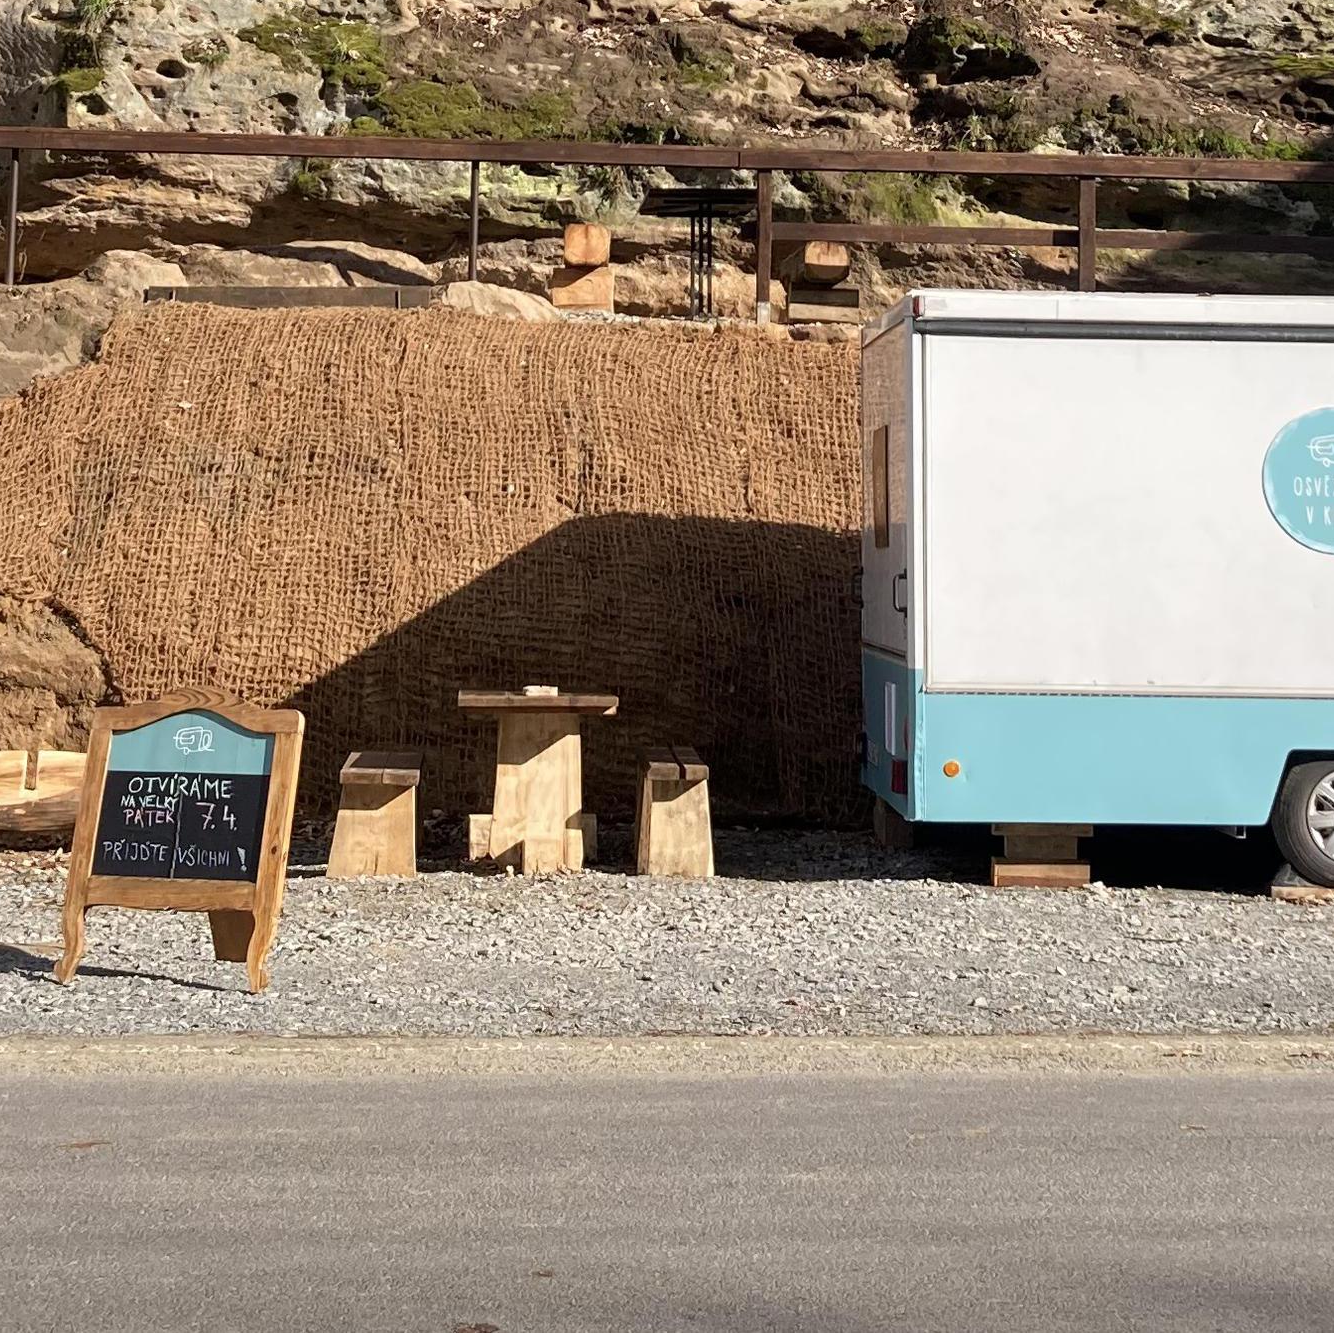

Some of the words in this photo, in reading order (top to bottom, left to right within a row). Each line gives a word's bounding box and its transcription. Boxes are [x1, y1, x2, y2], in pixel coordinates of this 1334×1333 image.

[1306, 506, 1314, 524] V
[128, 773, 233, 800] OTVÍRÁME
[120, 794, 136, 808] NA
[123, 807, 175, 828] PÁTEK
